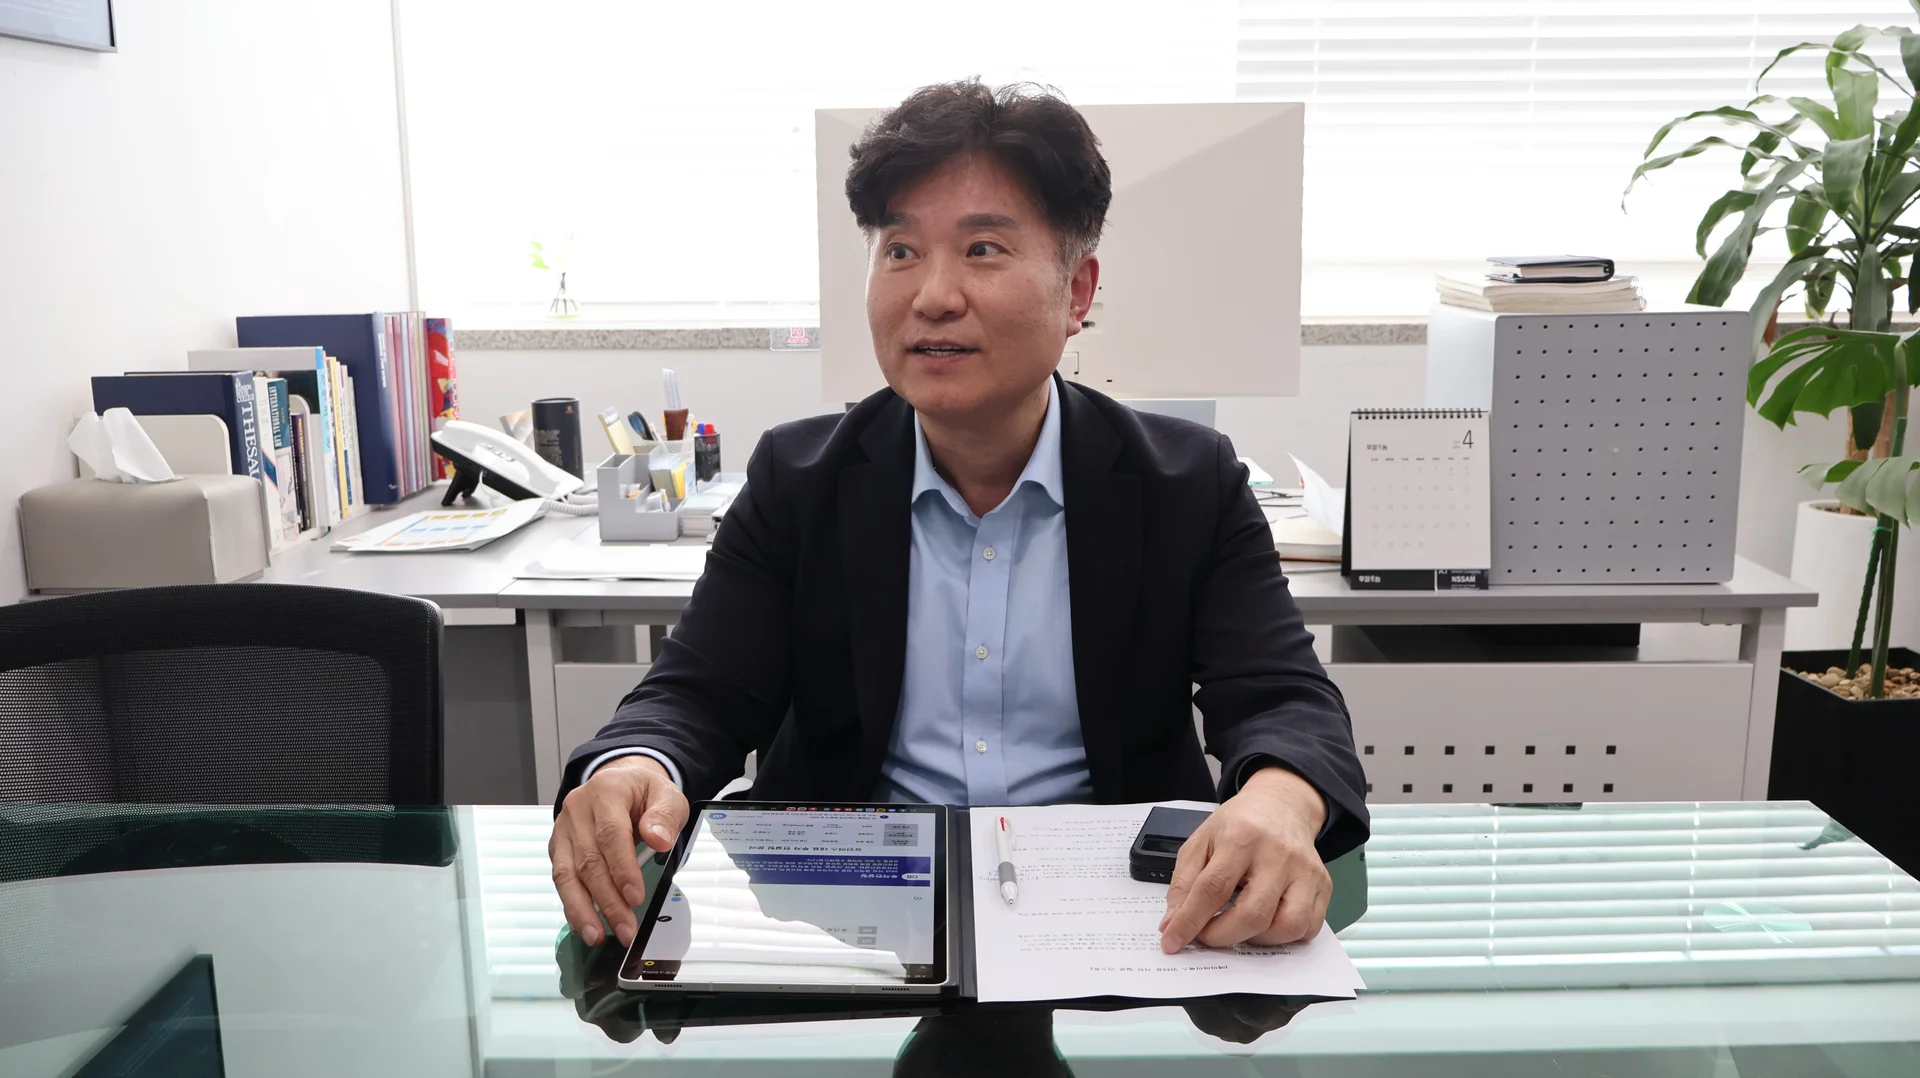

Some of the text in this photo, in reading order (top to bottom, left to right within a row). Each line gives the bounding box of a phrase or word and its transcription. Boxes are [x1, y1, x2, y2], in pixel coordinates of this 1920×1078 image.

[269, 386, 282, 447] INTERNATIONAL LAW
[1462, 430, 1474, 449] 4
[1451, 575, 1476, 583] NSSAM
